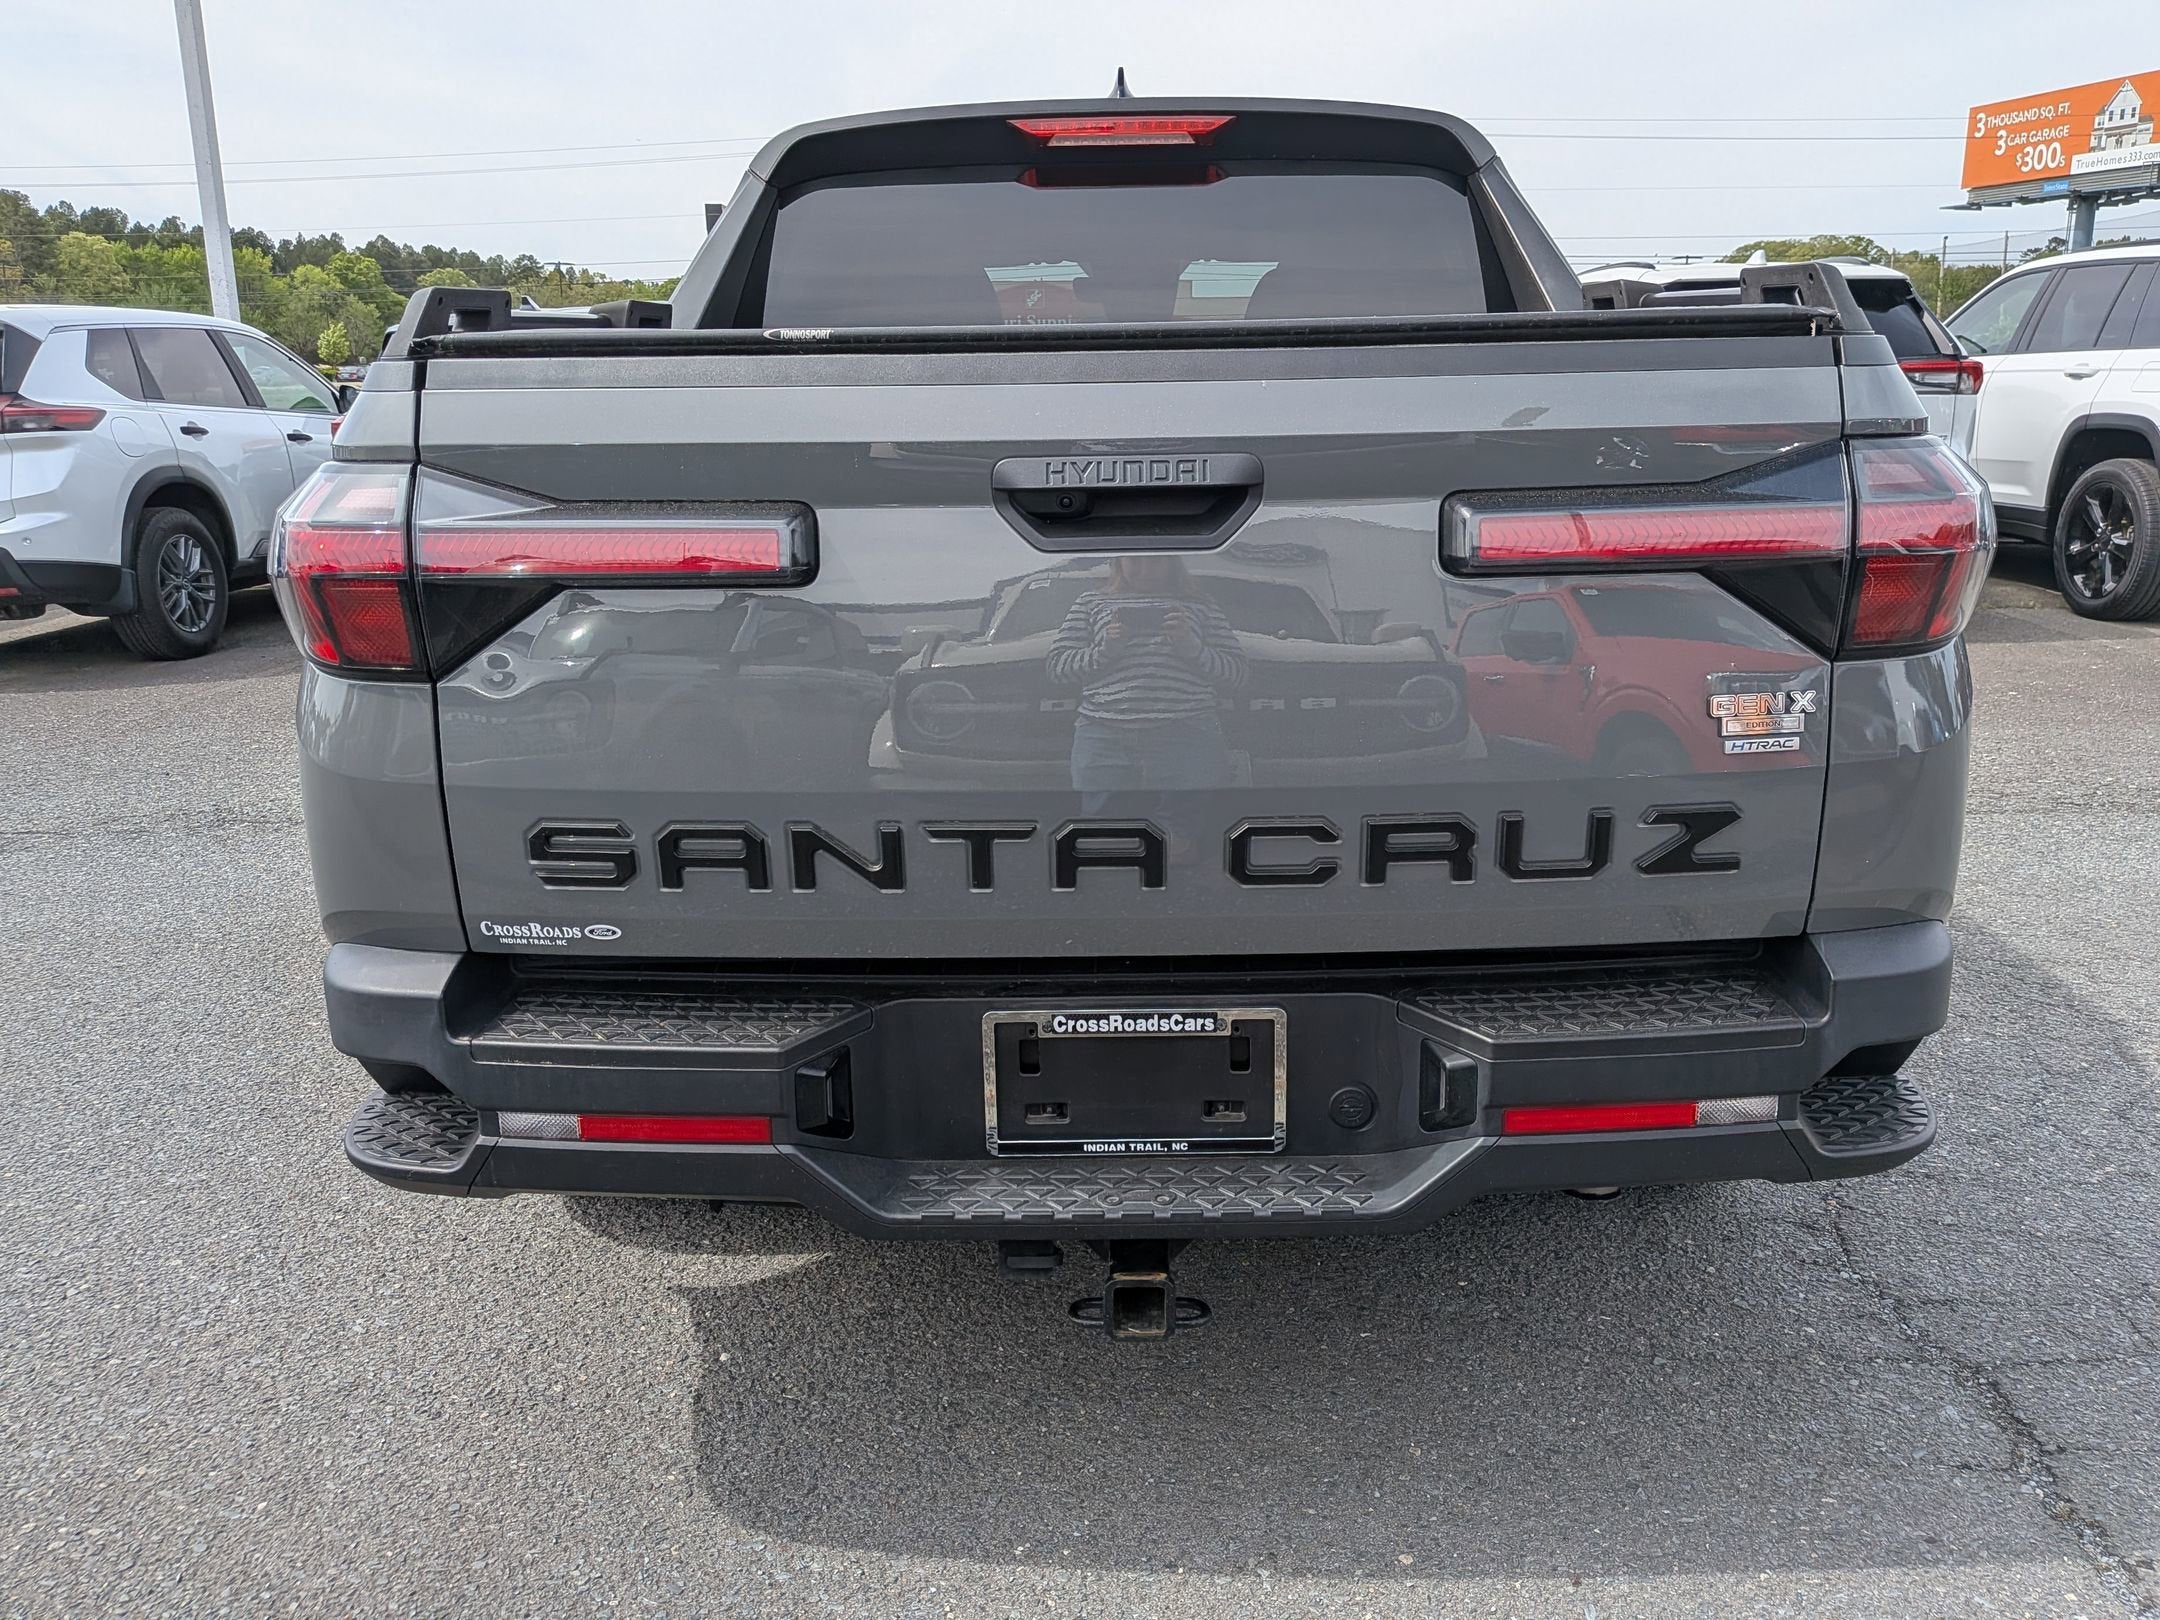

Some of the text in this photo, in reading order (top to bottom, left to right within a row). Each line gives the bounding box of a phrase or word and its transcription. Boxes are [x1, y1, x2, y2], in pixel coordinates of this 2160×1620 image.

[1974, 112, 1986, 138] 3
[1987, 108, 2039, 129] THOUSAND
[1994, 124, 2070, 156] 3 CAR GARAGE
[780, 329, 830, 339] TONNOSPORT
[1046, 459, 1209, 485] HYUNDAI
[1709, 689, 1817, 718] GEN X
[1745, 721, 1780, 729] EDITION
[1730, 739, 1794, 752] HTRAC
[526, 802, 1742, 894] SANTA CRUZ
[1053, 1014, 1215, 1033] CrossRoadsCars
[1083, 1142, 1189, 1152] INDIAN TRAIL, NC
